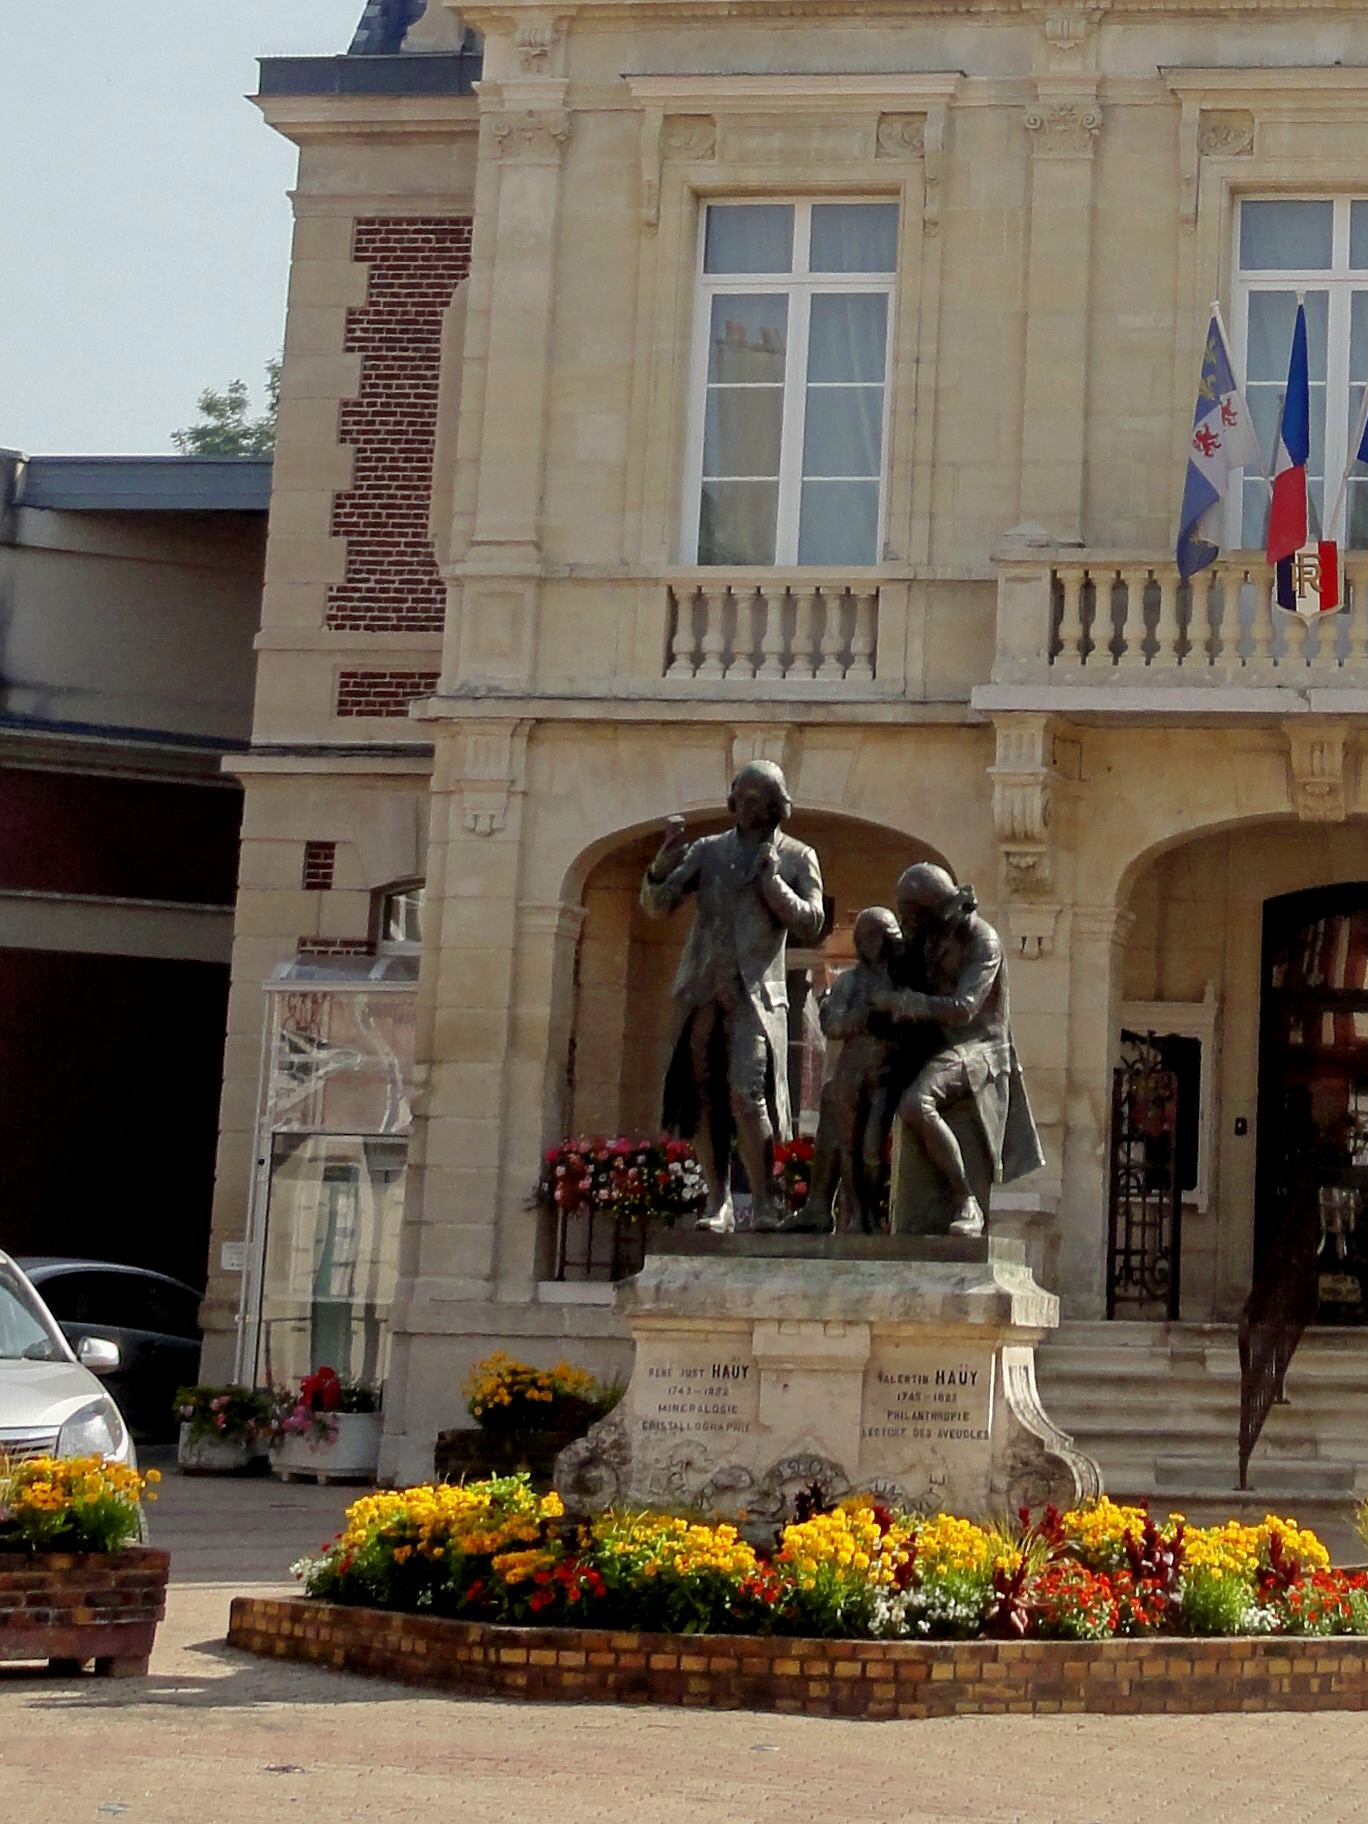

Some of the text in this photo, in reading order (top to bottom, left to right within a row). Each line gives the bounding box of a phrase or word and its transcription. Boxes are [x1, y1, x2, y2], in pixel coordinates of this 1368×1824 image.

[680, 1368, 705, 1378] JUST
[878, 1369, 929, 1385] VALENTIN
[886, 1410, 970, 1422] PHILANTHROPIE
[912, 1428, 933, 1439] DES
